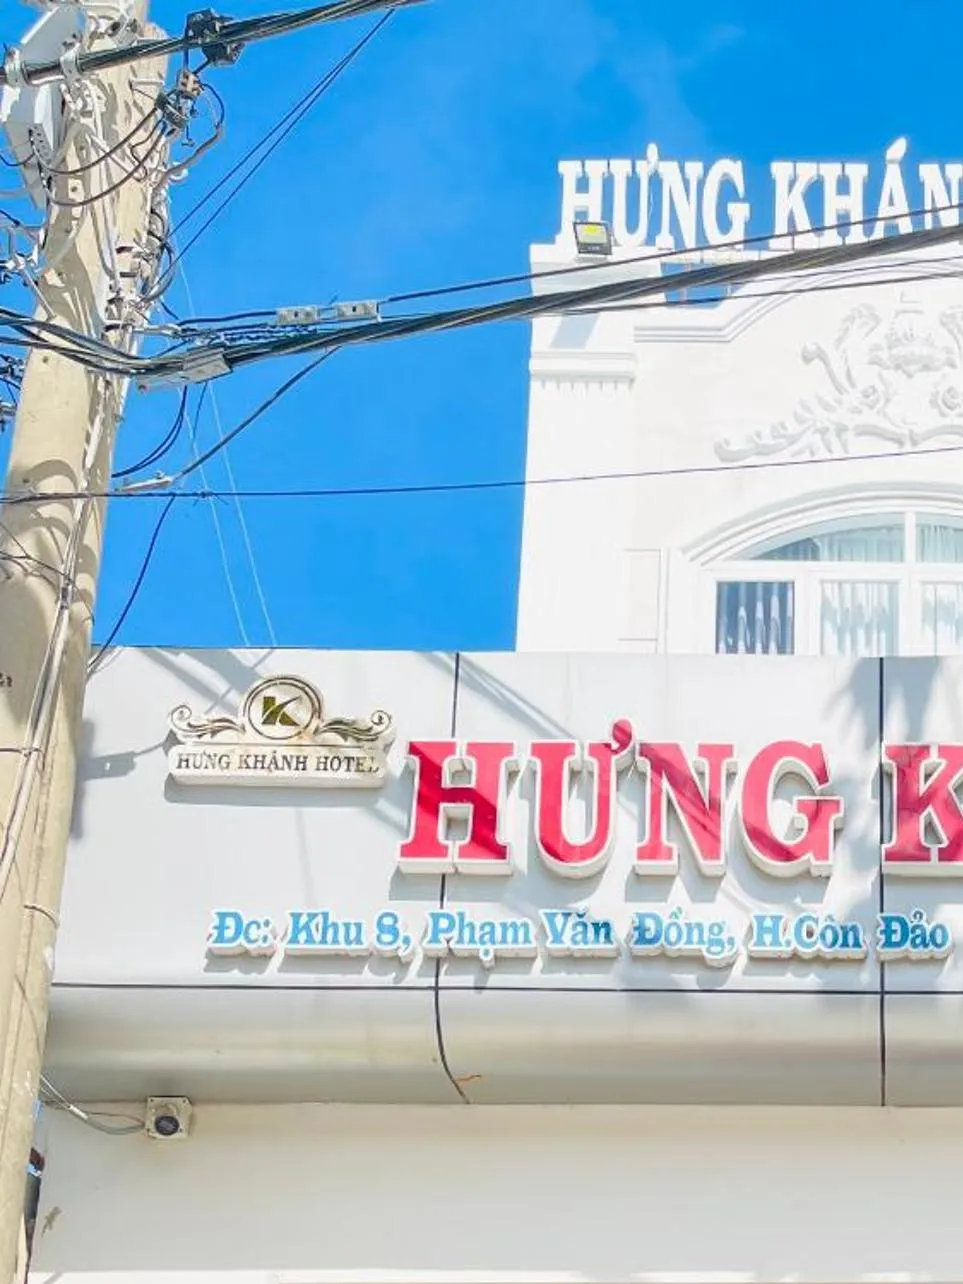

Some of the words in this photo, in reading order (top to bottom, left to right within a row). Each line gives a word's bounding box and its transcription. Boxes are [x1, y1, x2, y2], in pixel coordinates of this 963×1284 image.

[556, 143, 750, 252] HƯNG
[175, 750, 231, 770] HƯNG
[238, 750, 308, 772] KHÁNH
[315, 756, 380, 774] HOTEL
[398, 716, 845, 870] HƯNG
[212, 910, 271, 946] Đc:
[286, 910, 365, 947] Khu
[375, 910, 413, 955] 8,
[427, 911, 534, 958] Phạm
[548, 905, 614, 947] Văn
[634, 905, 736, 957] Đồng,
[751, 912, 863, 950] H.Côn
[879, 909, 950, 951] Đảo
